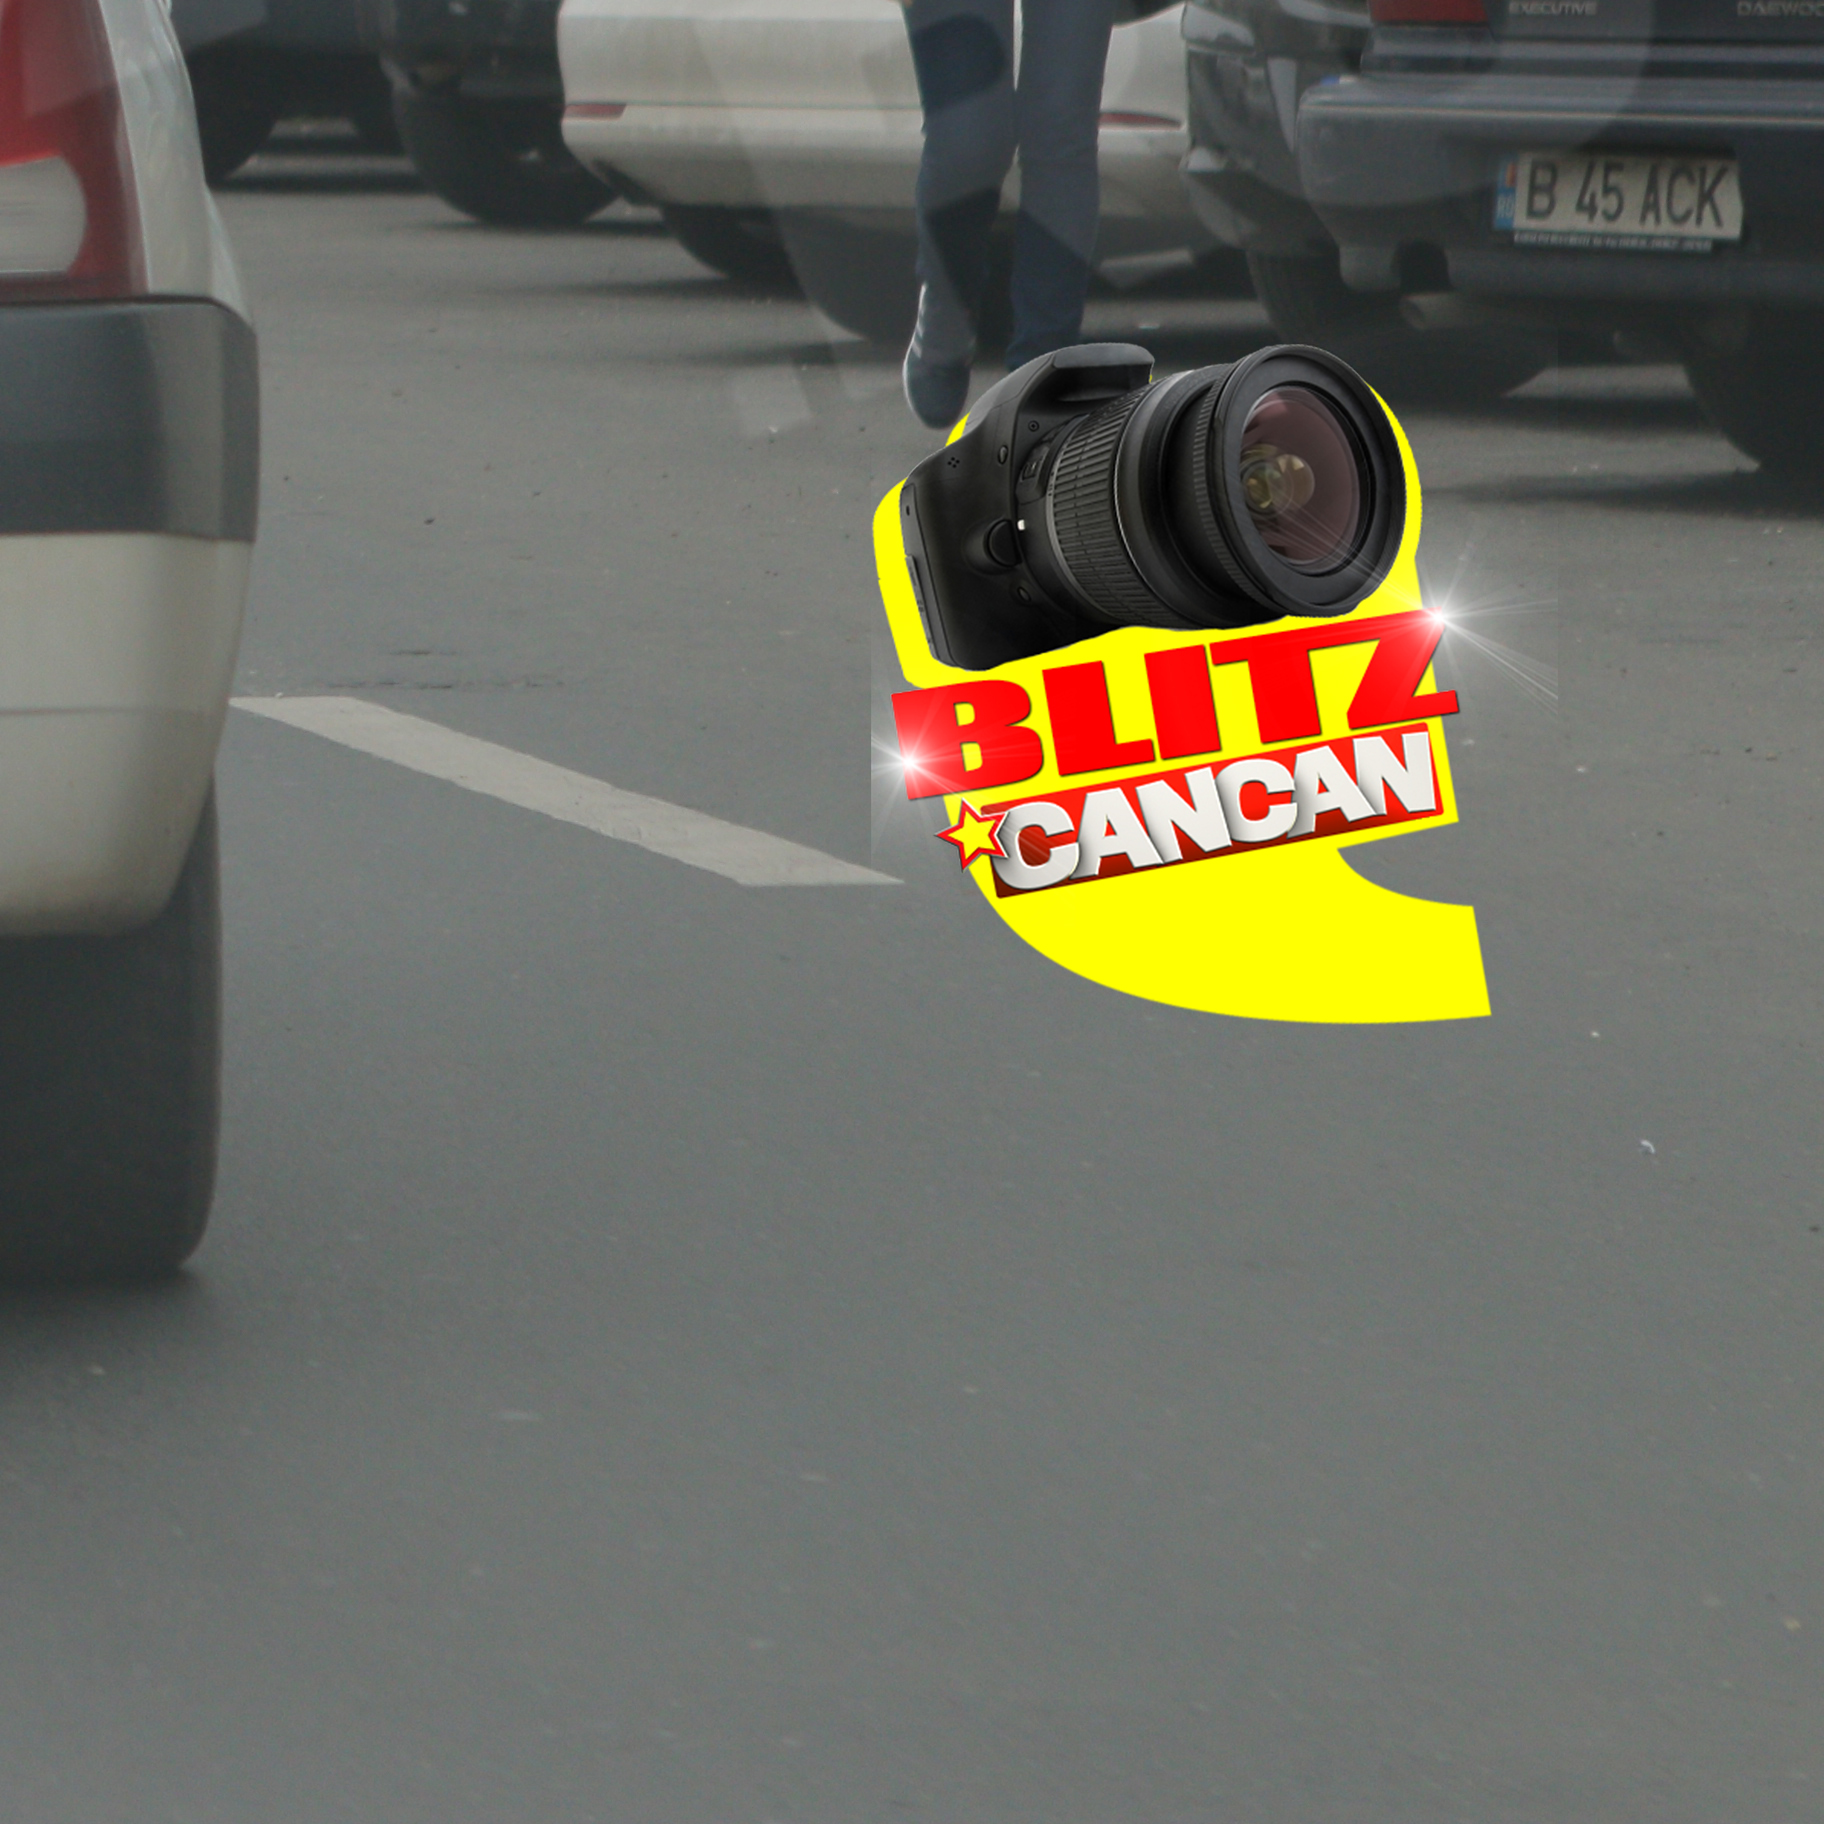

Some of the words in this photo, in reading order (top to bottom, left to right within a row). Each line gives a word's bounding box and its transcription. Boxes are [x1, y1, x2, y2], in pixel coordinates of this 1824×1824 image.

[1509, 1, 1598, 16] EXECUTIVE
[1526, 161, 1558, 219] B
[1575, 161, 1625, 223] 45
[1638, 165, 1729, 228] ACK
